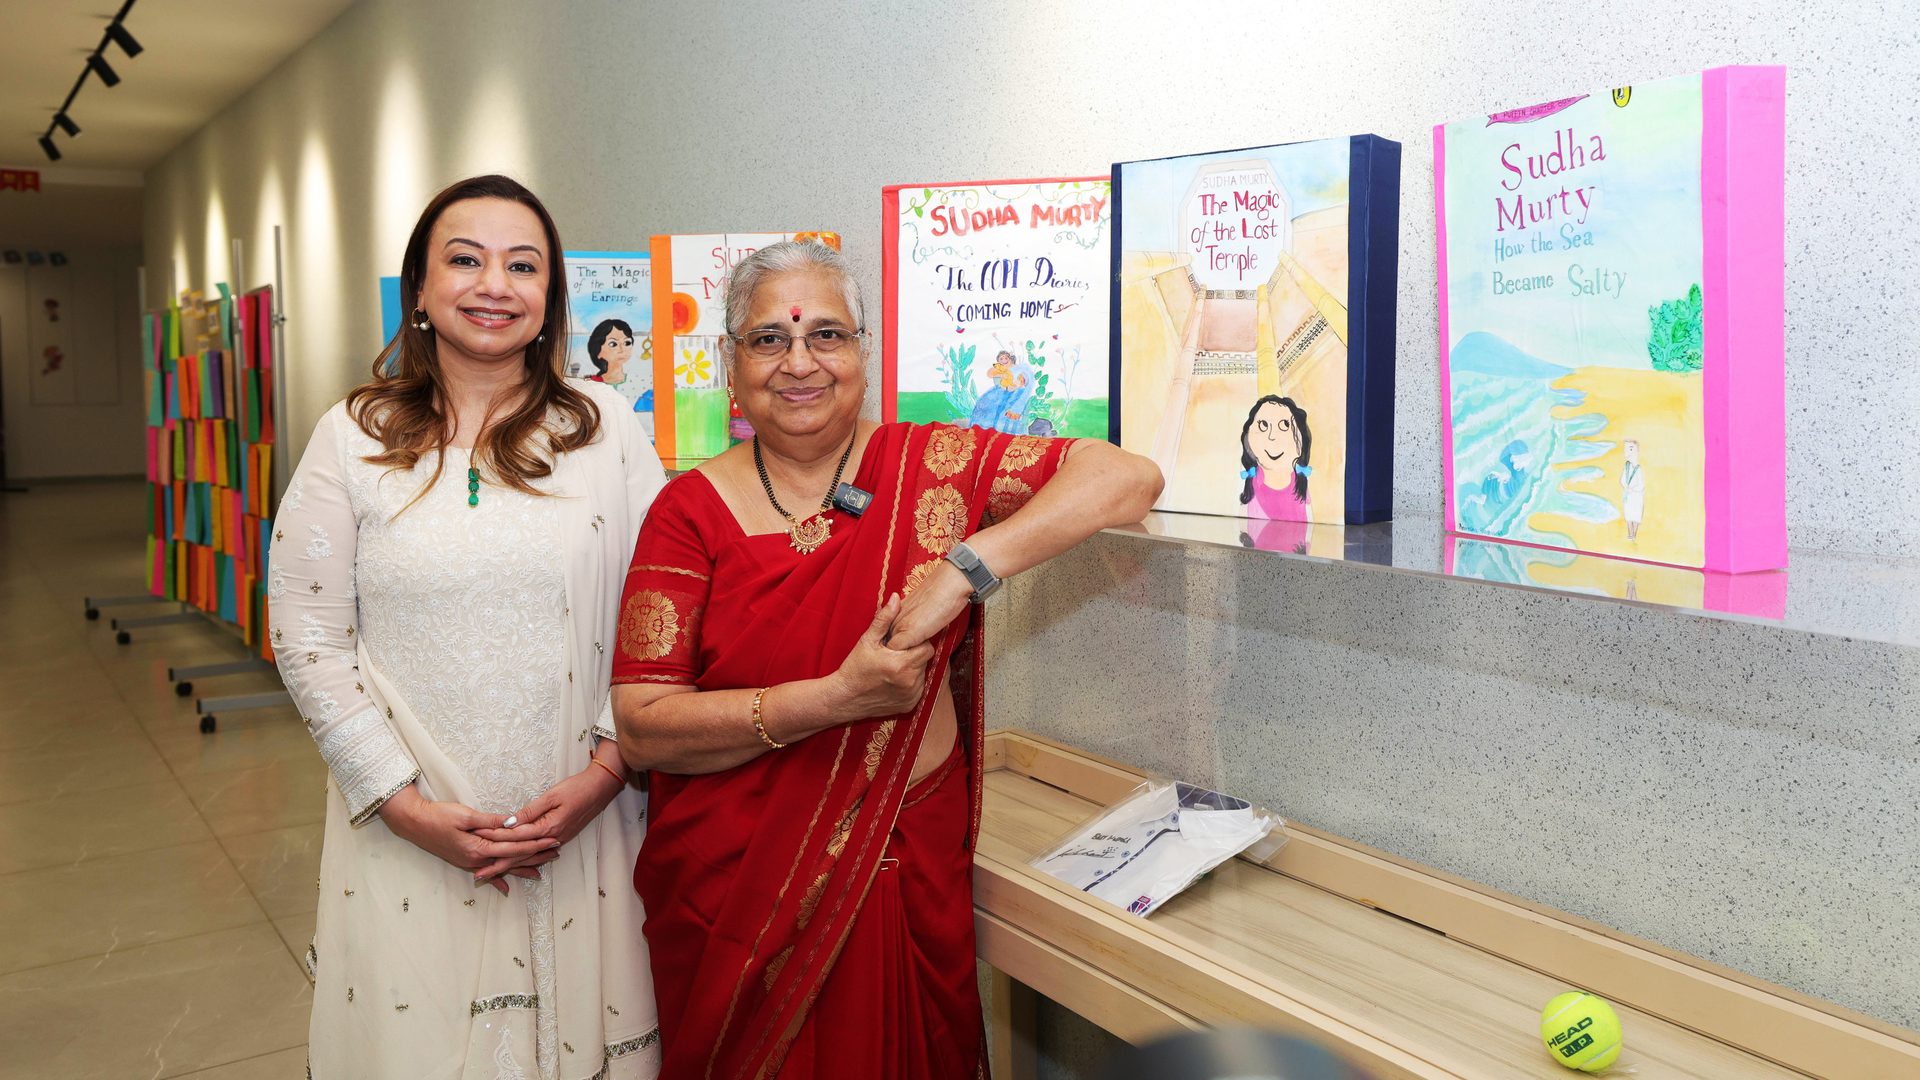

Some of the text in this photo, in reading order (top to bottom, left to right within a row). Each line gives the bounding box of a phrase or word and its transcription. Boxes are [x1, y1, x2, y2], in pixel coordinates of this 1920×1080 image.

[1501, 128, 1606, 191] Sudha
[1203, 172, 1270, 189] SUDHA MURTY
[930, 195, 1108, 237] SUDHA MURTY
[1198, 190, 1280, 221] The Magic
[1496, 186, 1595, 232] Murty
[1191, 218, 1278, 253] of the Lost
[1494, 222, 1594, 264] How the Sea
[576, 265, 650, 283] The Magic
[935, 263, 974, 291] The
[1205, 244, 1258, 281] Temple
[1492, 263, 1627, 299] Became Salty
[957, 299, 1055, 322] COMING HOME
[1547, 1016, 1593, 1048] HEAD
